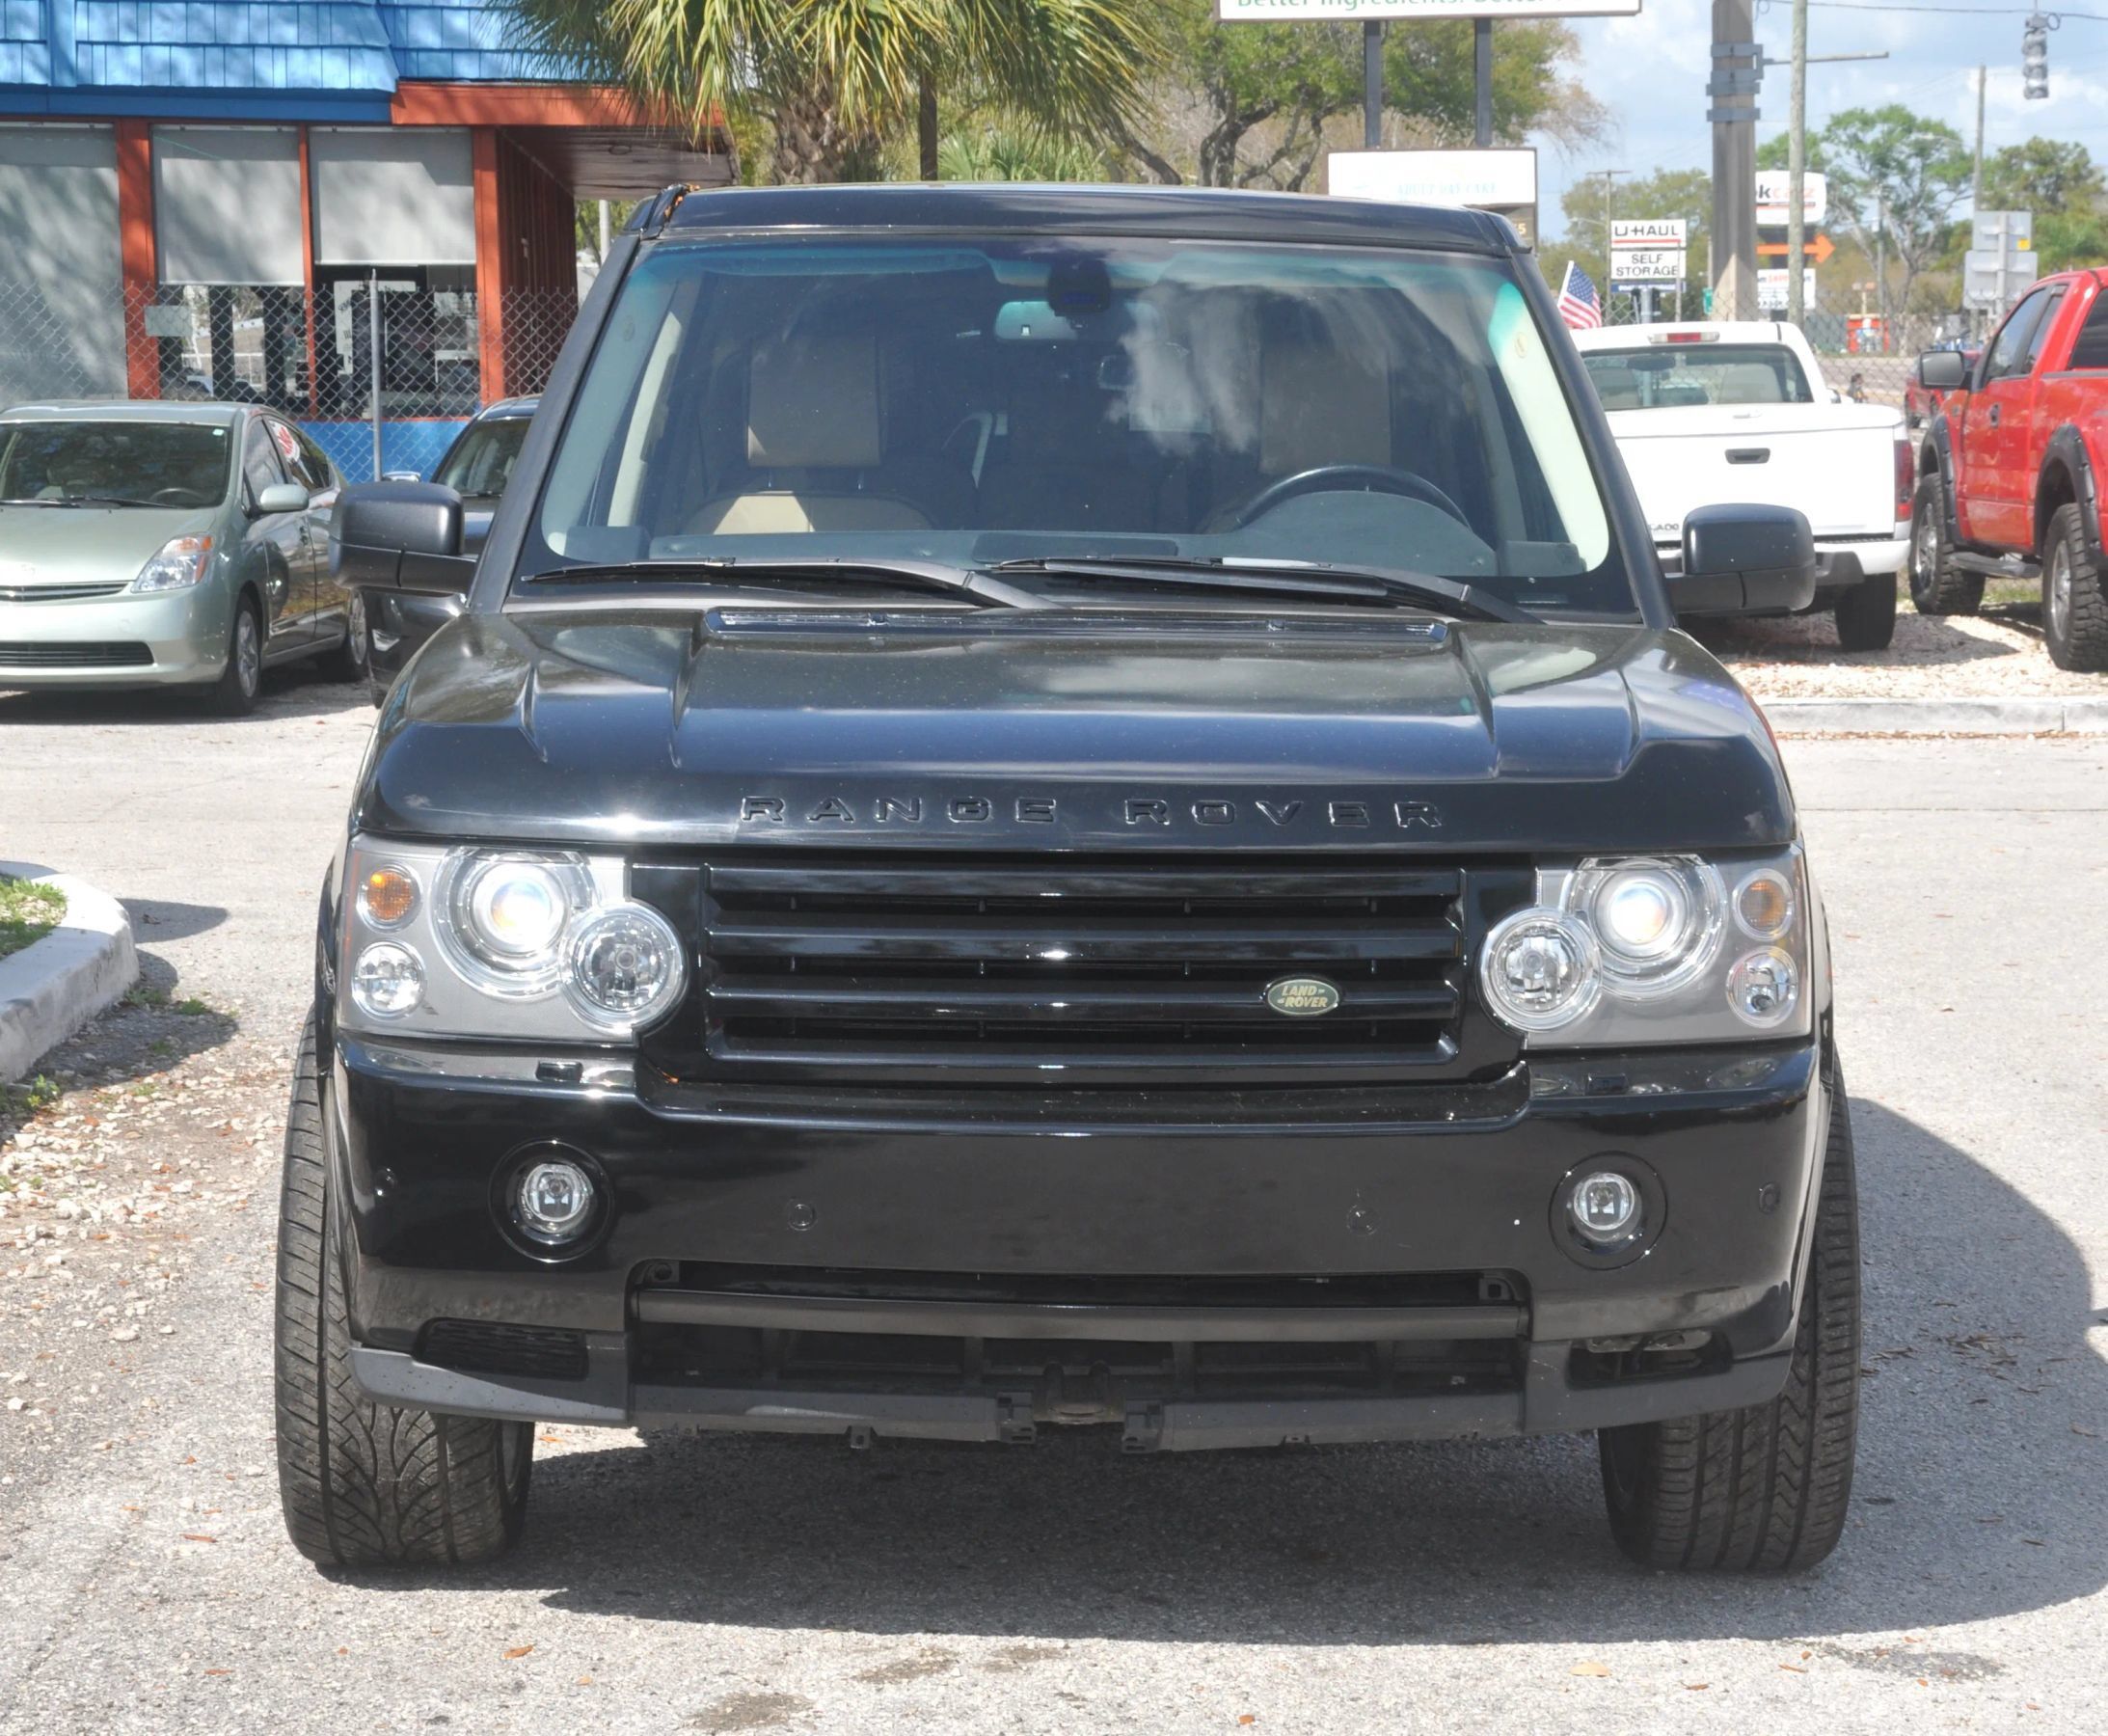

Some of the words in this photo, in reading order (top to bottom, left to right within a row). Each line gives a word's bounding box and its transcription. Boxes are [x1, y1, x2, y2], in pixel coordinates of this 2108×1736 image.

[1631, 253, 1663, 264] SELF
[1615, 265, 1679, 277] STORAGE
[740, 795, 1057, 825] RANGE
[1124, 798, 1443, 828] ROVER
[1282, 985, 1317, 996] LAND
[1284, 996, 1328, 1008] ROVER
